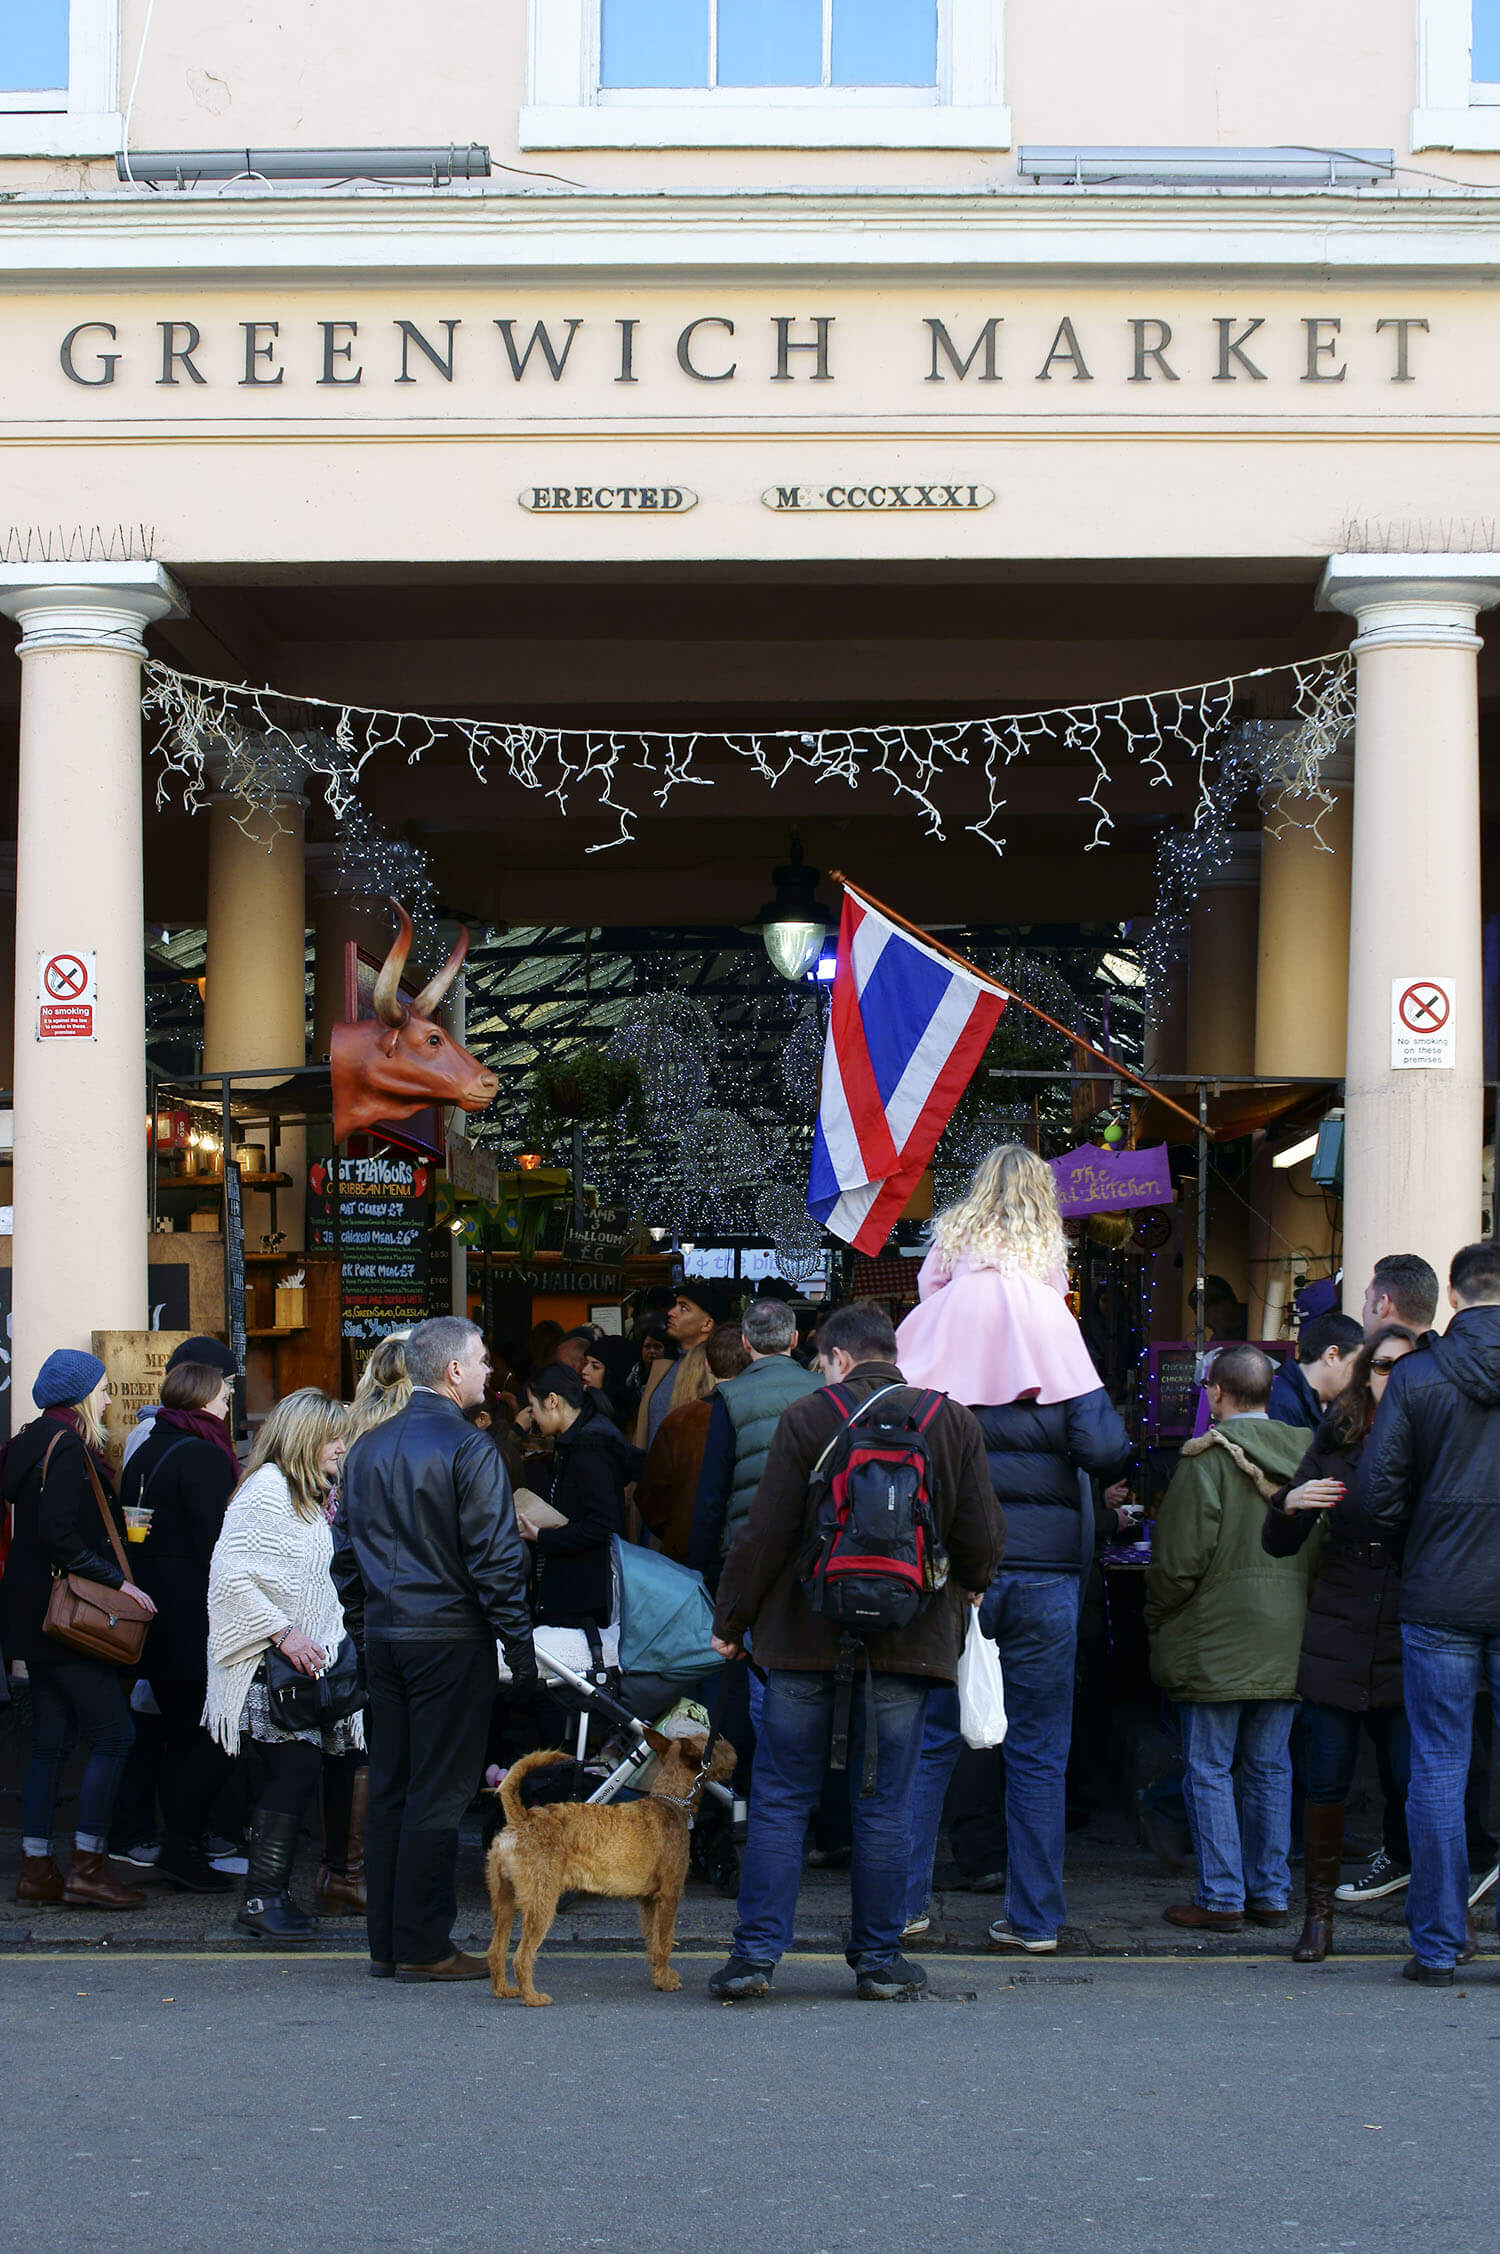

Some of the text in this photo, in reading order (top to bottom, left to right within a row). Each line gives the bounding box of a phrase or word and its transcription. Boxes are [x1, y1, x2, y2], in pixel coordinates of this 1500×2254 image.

[60, 315, 1430, 387] GREENWICH MARKET
[530, 487, 684, 510] ERECTED
[42, 1007, 90, 1016] No smoking
[1413, 1038, 1449, 1046] smoking
[1069, 1164, 1111, 1184] The
[326, 1182, 411, 1196] CRIBBEAN MENU
[340, 1229, 371, 1244] CHICKEN
[371, 1230, 396, 1245] MEAL
[580, 1244, 605, 1261] £6
[399, 1263, 416, 1278] £7
[121, 1382, 155, 1396] BEEF
